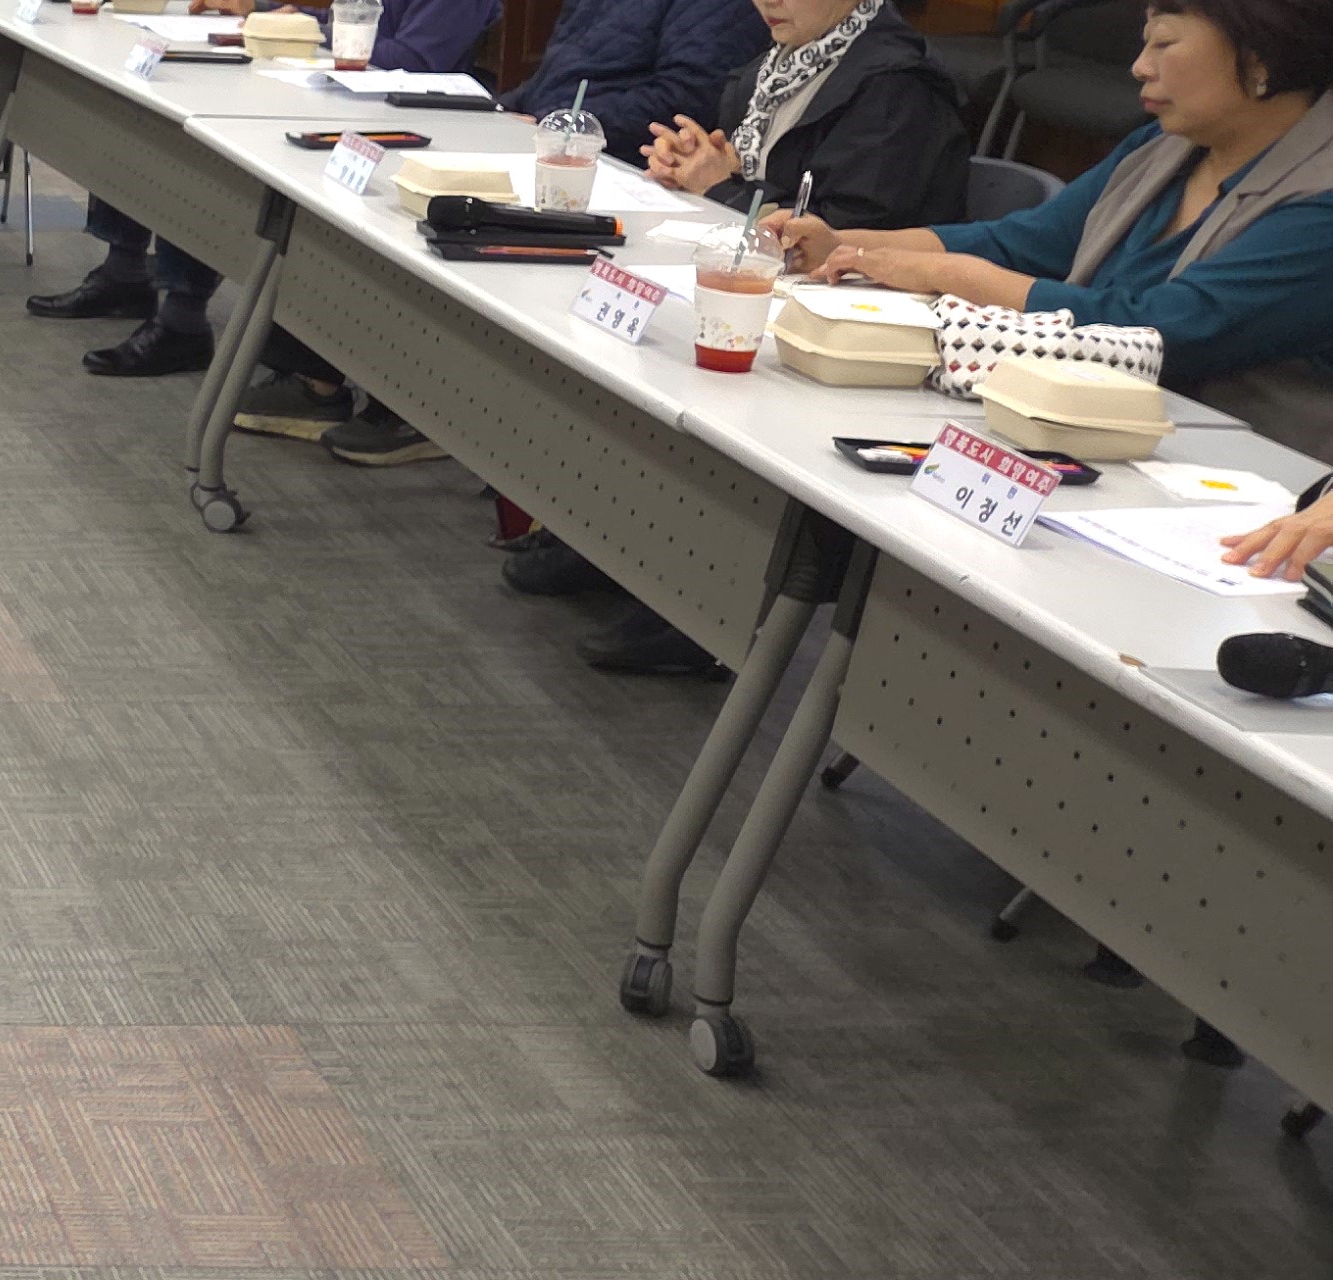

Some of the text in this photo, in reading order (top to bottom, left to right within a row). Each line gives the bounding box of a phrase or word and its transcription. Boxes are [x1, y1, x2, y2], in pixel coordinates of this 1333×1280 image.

[944, 428, 1054, 493] 행복도시 희망여주
[955, 485, 1023, 537] 이정선
